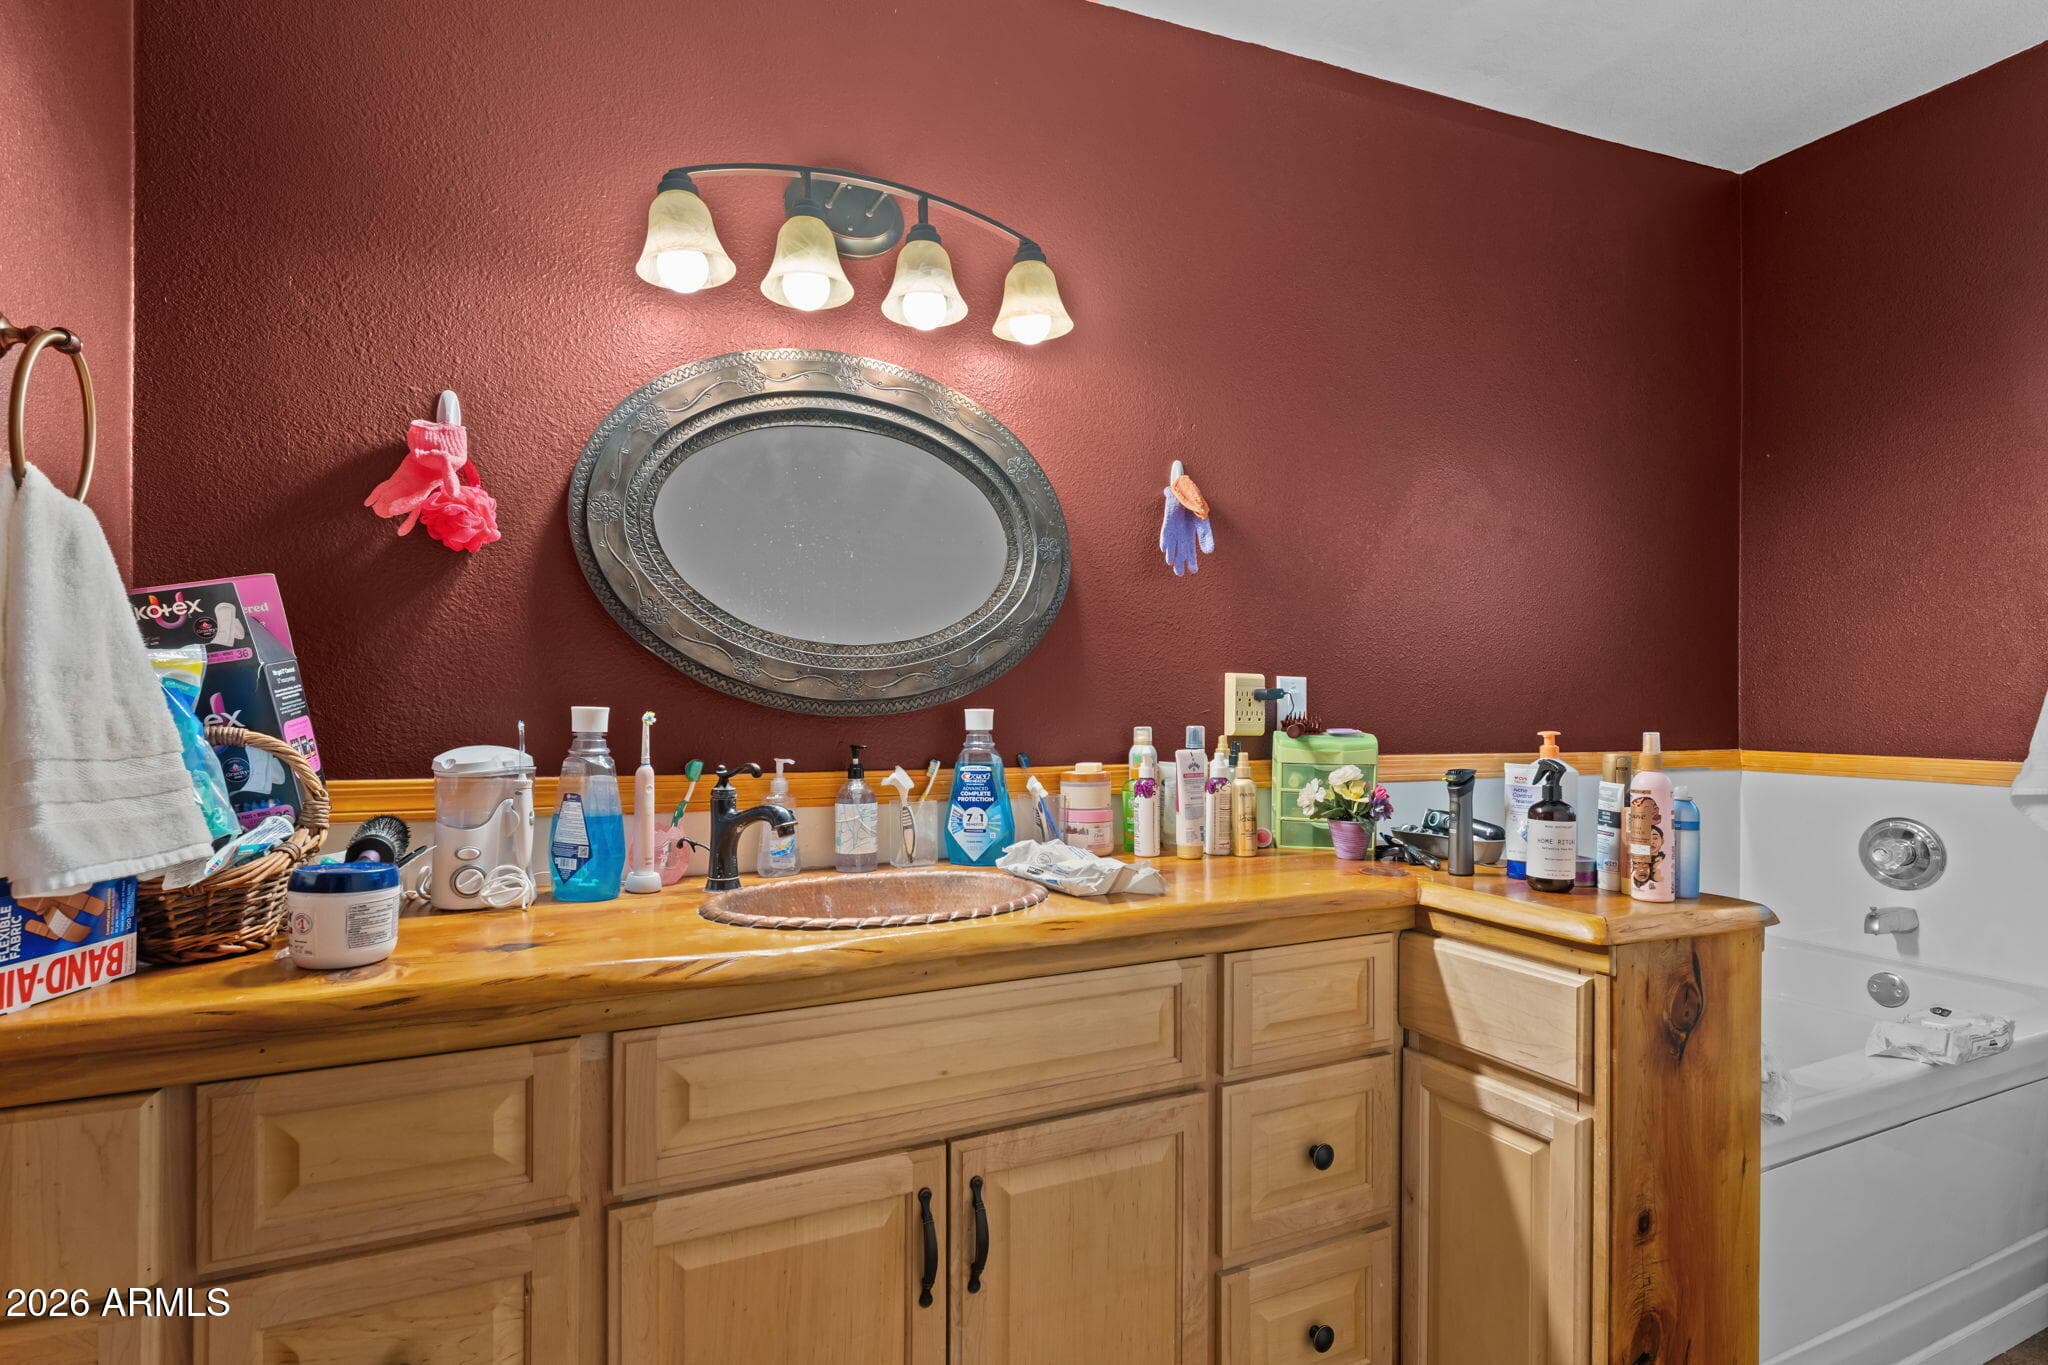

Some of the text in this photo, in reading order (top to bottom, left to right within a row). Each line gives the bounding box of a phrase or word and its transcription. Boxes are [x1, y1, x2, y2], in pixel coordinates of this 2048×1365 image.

[236, 649, 249, 659] 36
[966, 813, 984, 822] 7 1
[0, 905, 13, 962] FLEXIBLE
[9, 914, 23, 960] FABRIC
